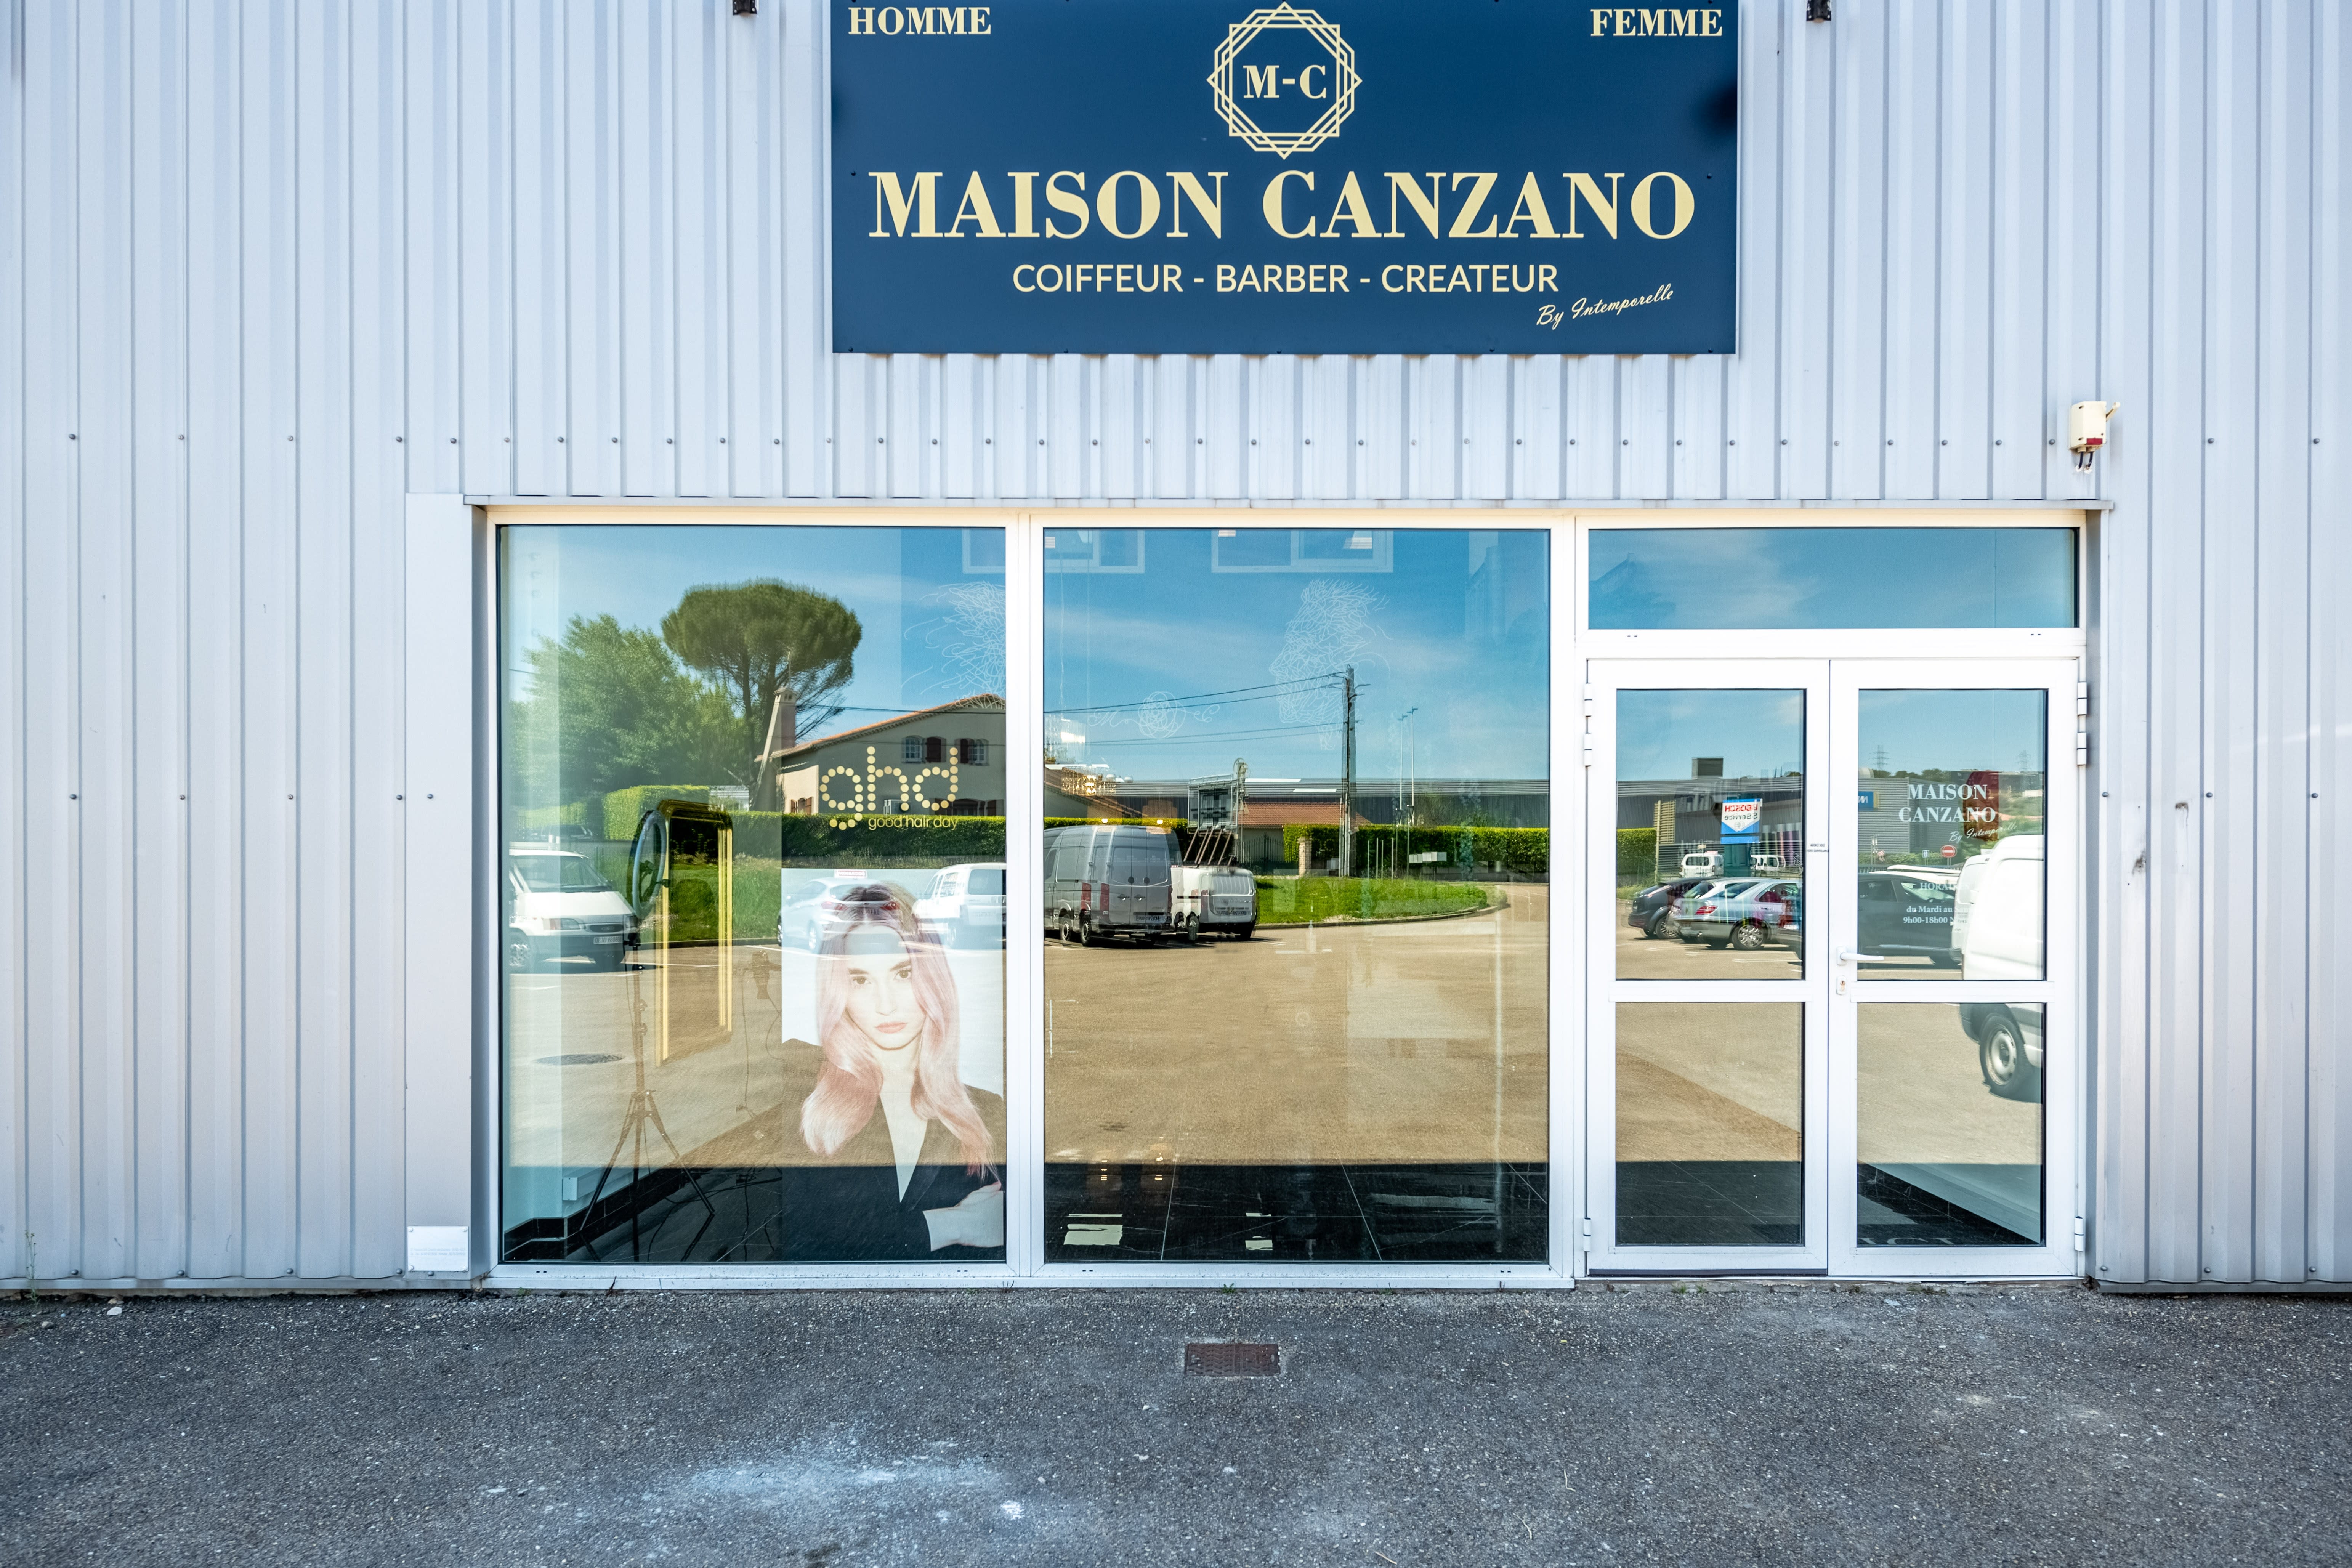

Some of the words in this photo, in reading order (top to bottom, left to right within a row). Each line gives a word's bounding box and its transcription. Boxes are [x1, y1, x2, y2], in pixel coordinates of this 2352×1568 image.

[848, 6, 992, 35] HOMME
[1590, 8, 1723, 37] FEMME
[1243, 65, 1327, 99] M-C
[868, 170, 1229, 239] MAISON
[1262, 170, 1695, 240] CANZANO
[1013, 264, 1183, 293] COIFFEUR
[1217, 264, 1350, 293] BARBER
[1381, 264, 1559, 293] CREATEUR
[1536, 303, 1564, 330] By
[1571, 283, 1674, 319] Intemporelle
[819, 746, 959, 830] ghd
[1907, 784, 1988, 800] MAISON
[1898, 807, 1996, 823] CANZANO
[1949, 830, 1963, 844] By
[1903, 916, 1948, 924] 9h00-18h00
